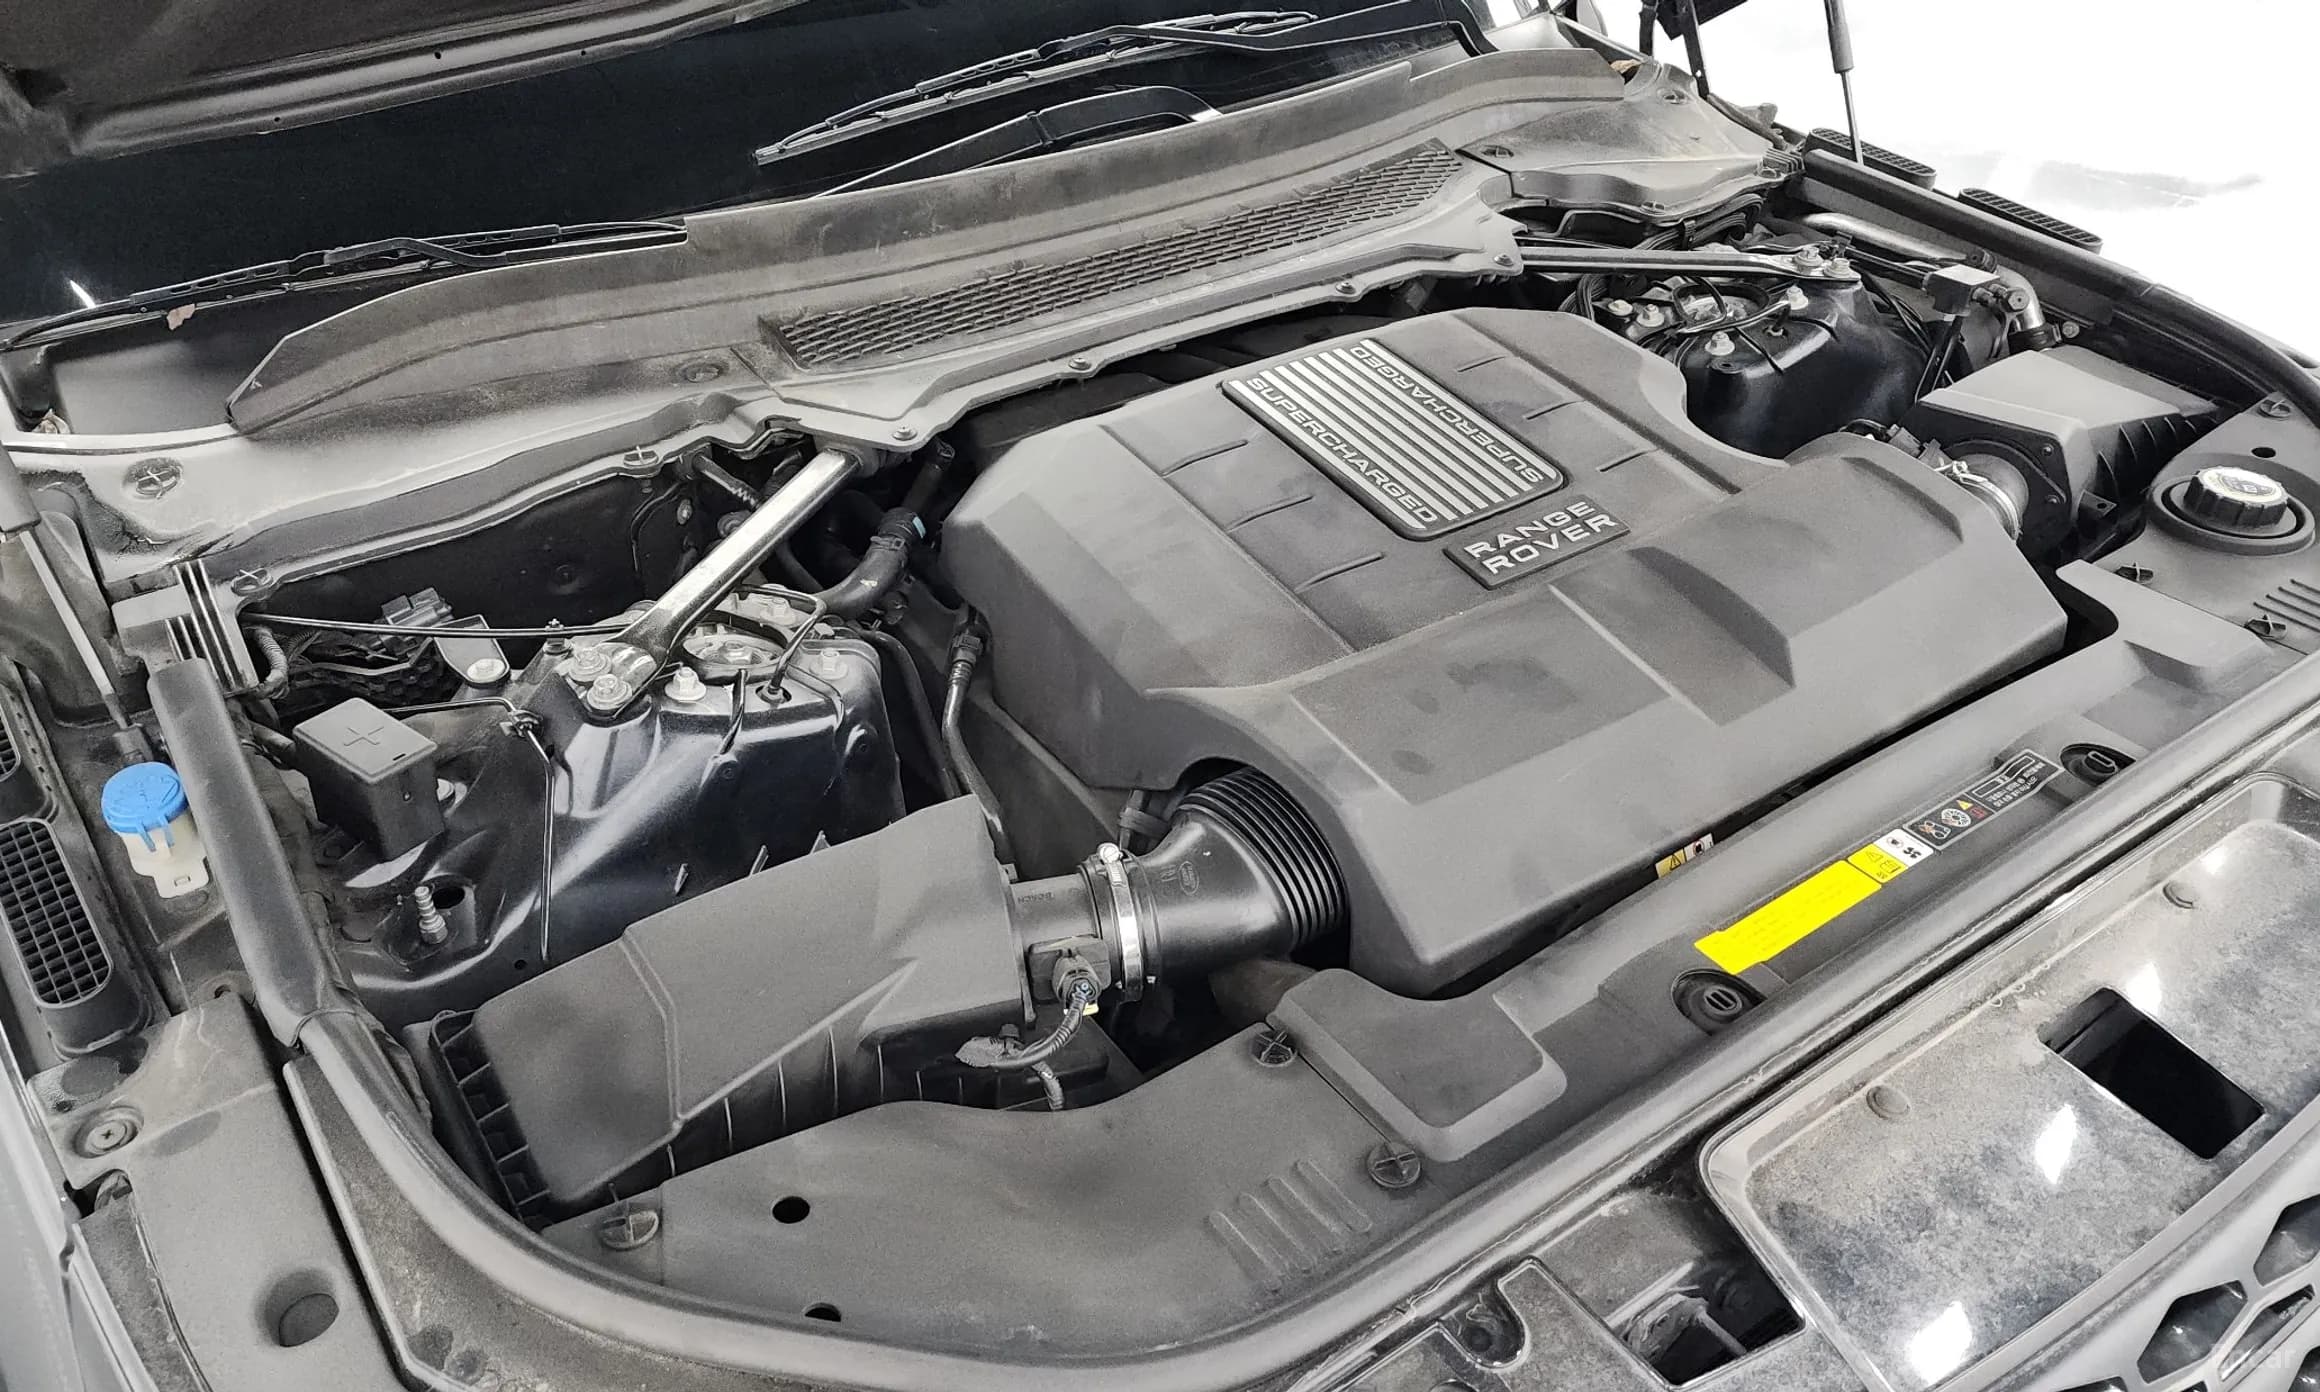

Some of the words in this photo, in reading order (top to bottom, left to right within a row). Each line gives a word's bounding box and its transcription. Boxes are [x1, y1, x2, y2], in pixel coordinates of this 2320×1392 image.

[1247, 377, 1438, 524] SUPERCHARGED
[1351, 345, 1545, 484] SUPERCHARGED
[1464, 500, 1598, 559] RANGE
[1482, 513, 1618, 575] ROVER
